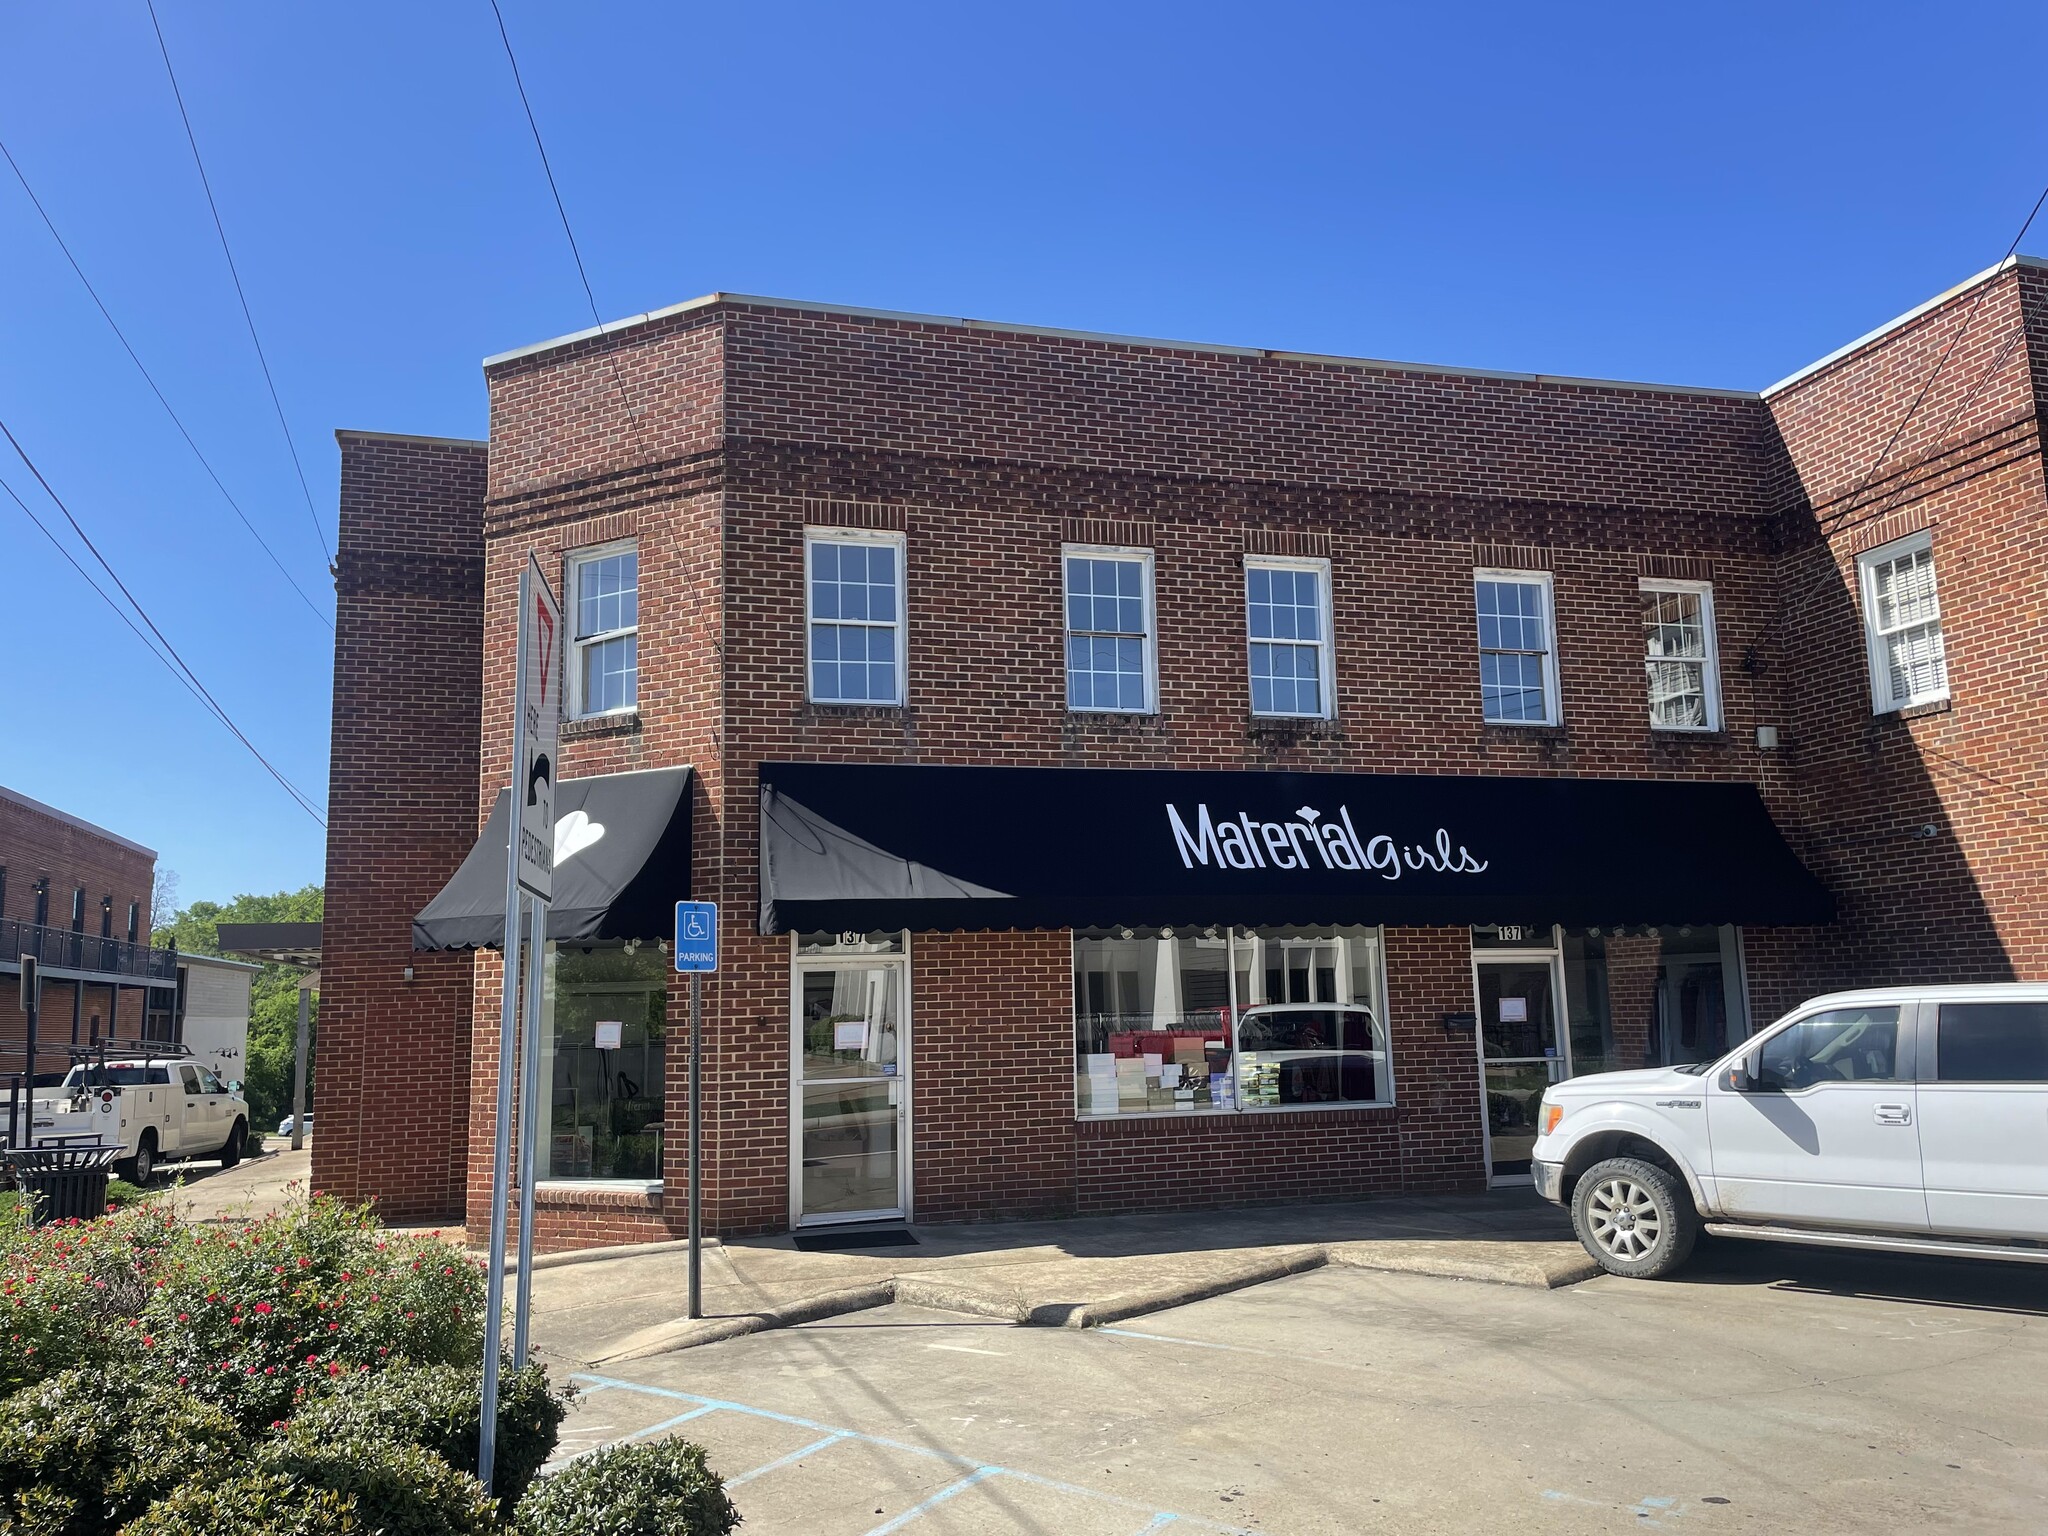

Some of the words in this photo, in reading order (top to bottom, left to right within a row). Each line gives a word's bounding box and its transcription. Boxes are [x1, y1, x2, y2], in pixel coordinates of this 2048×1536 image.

[527, 699, 539, 742] HERE
[542, 799, 549, 830] TO
[521, 826, 551, 875] PEDESTRIANS
[1500, 926, 1520, 940] 137
[679, 952, 714, 962] PARKING
